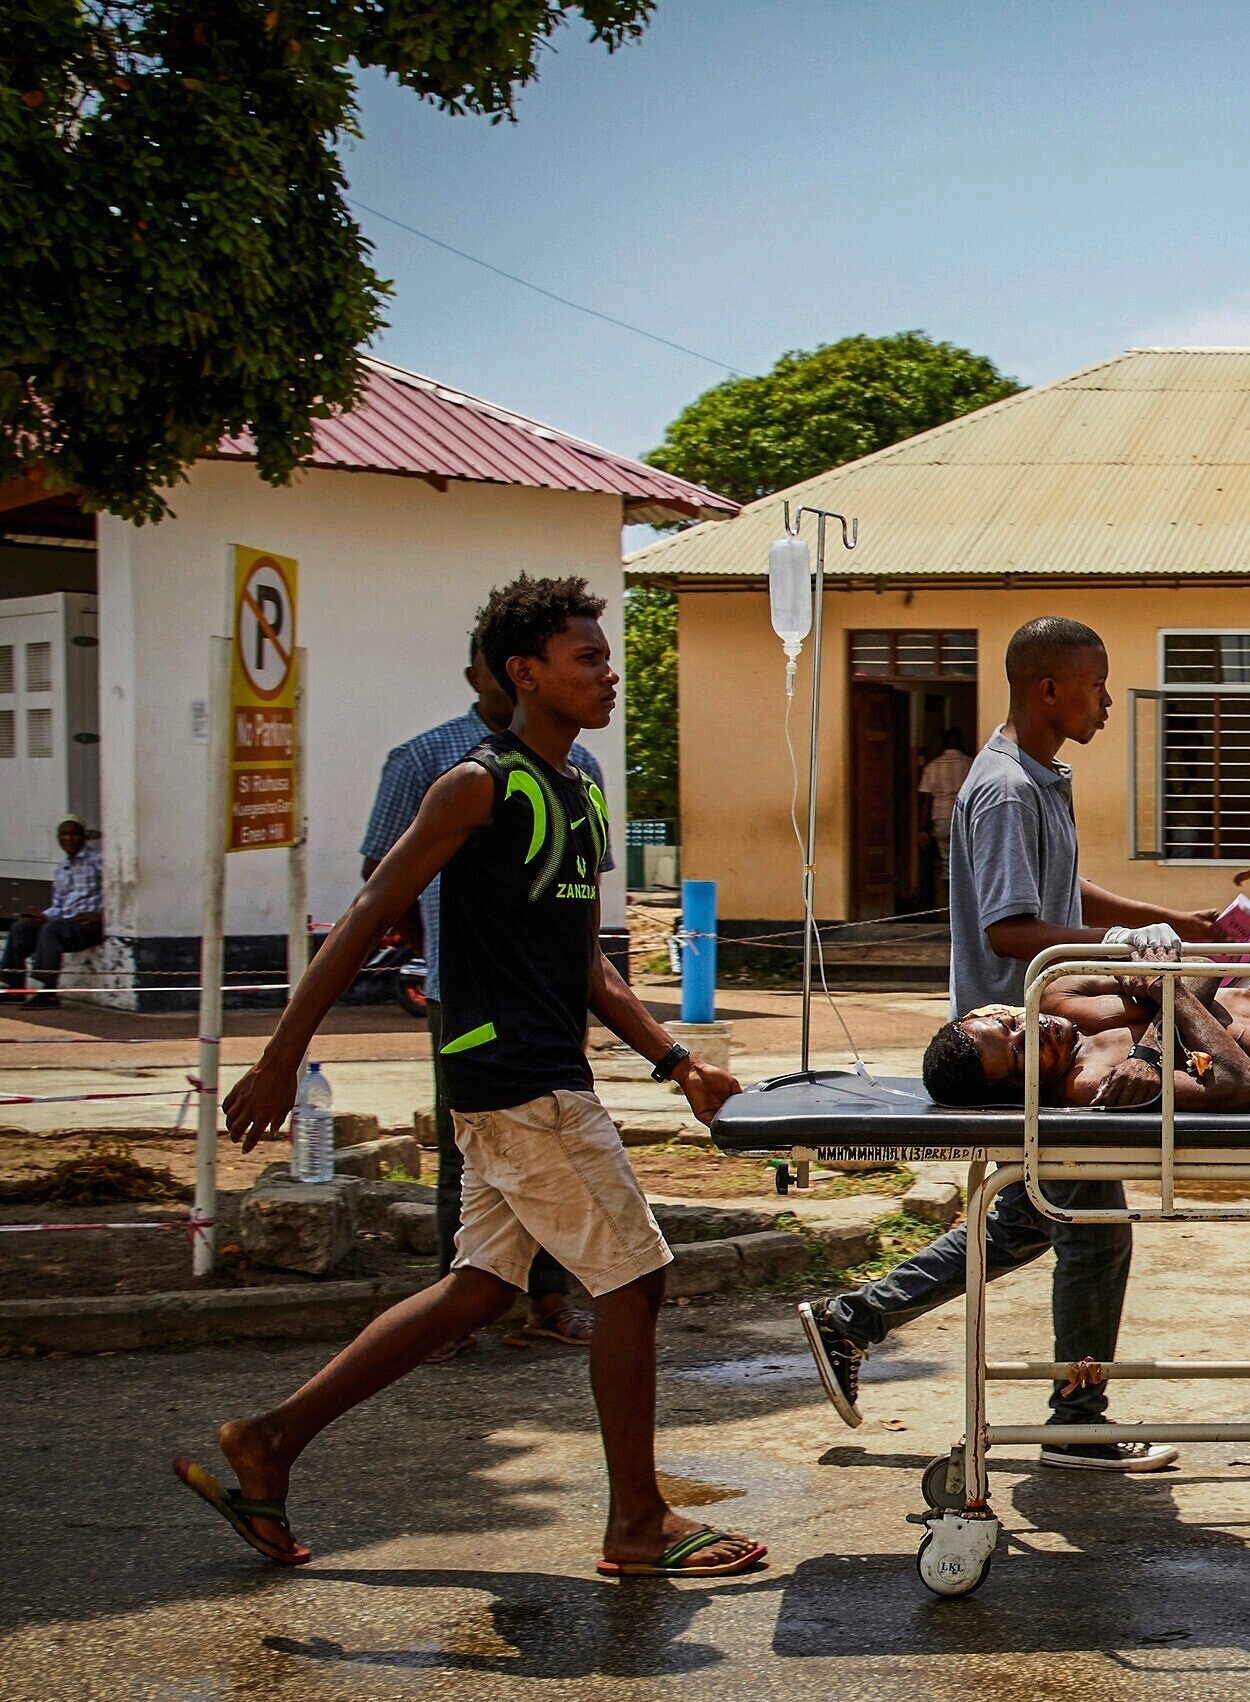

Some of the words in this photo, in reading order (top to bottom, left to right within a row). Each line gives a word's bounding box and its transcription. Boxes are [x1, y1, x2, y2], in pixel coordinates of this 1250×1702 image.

[236, 713, 253, 747] No
[254, 713, 292, 755] Parking
[941, 1562, 964, 1572] LKL
